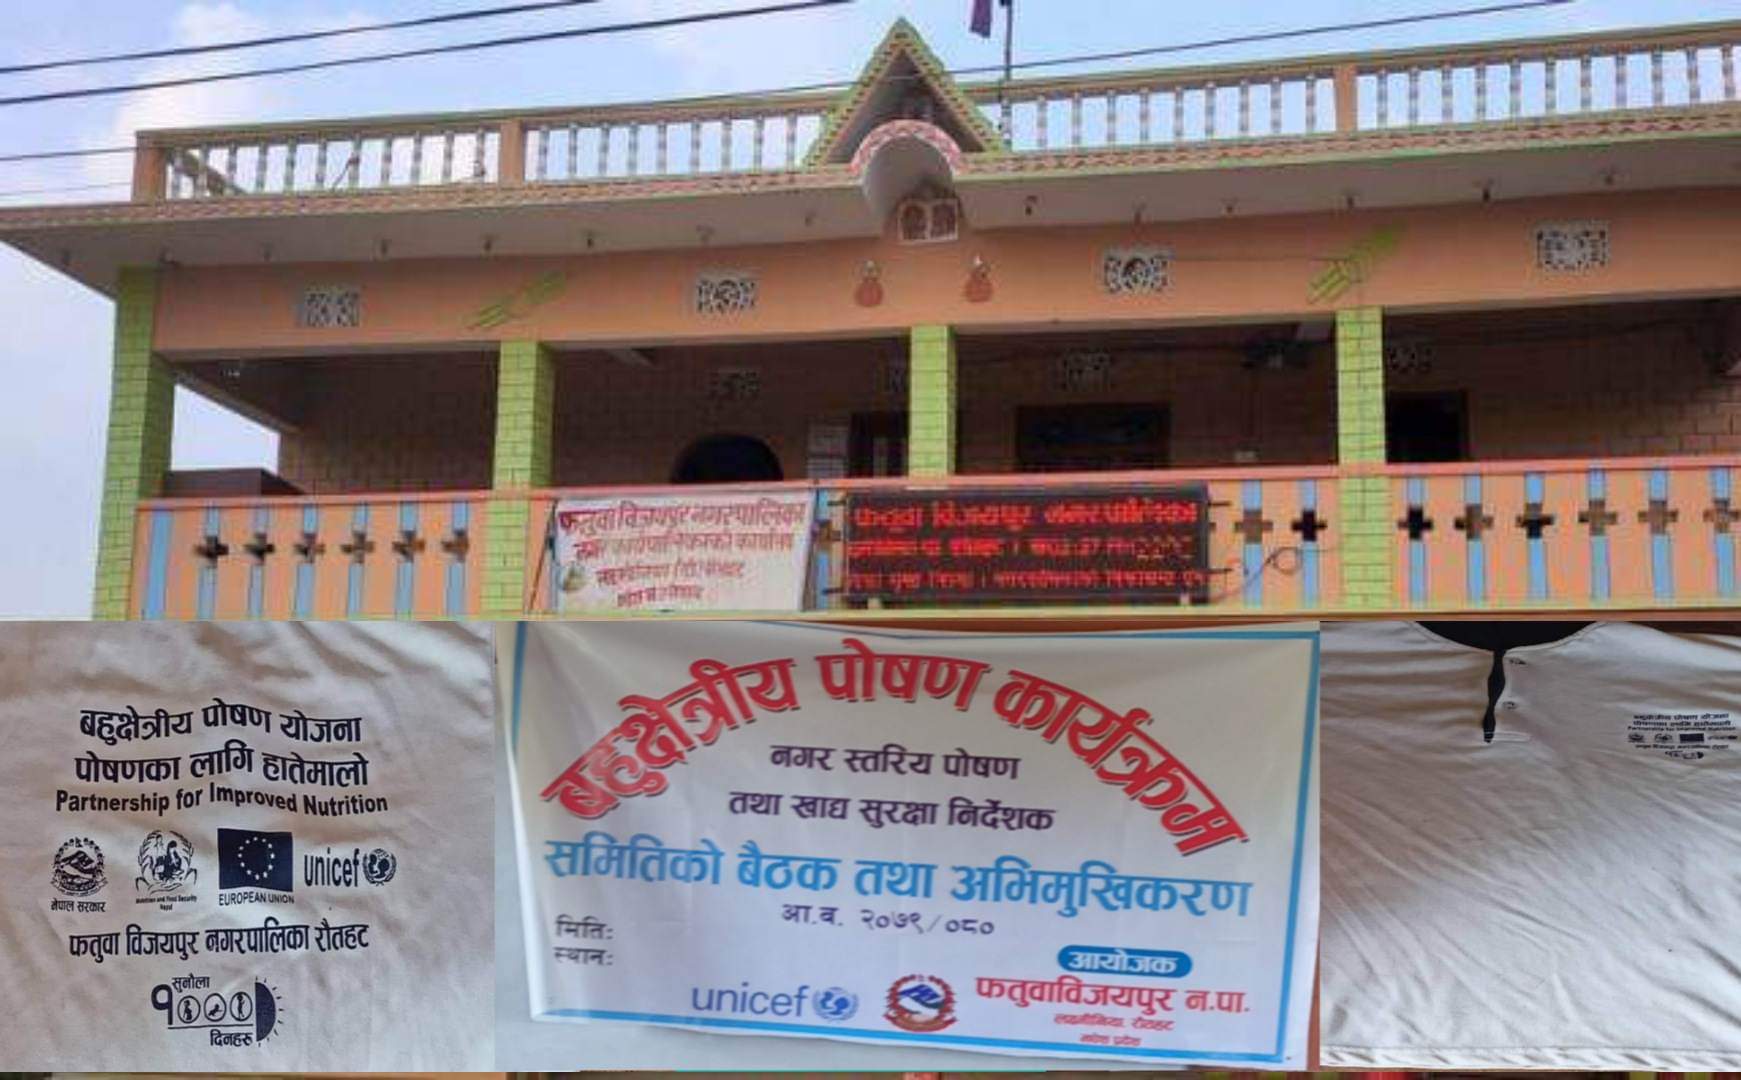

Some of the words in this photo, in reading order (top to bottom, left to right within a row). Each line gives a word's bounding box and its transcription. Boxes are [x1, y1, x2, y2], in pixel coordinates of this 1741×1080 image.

[80, 705, 194, 746] बहुक्षेत्रीय
[202, 698, 272, 733] पोषण
[280, 710, 362, 742] योजना
[75, 751, 182, 783] पोषणका
[190, 739, 254, 777] लागि
[262, 752, 369, 787] हातेमालो
[540, 657, 800, 819] बहुक्षेत्रीय
[815, 638, 993, 711] पोषण
[993, 668, 1250, 857] कार्यक्रम
[769, 743, 836, 774] नगर
[844, 746, 931, 777] स्तरिय
[942, 748, 1021, 780] पोषण
[55, 789, 170, 816] Partnership
[177, 788, 203, 810] for
[210, 783, 298, 813] Improved
[304, 795, 389, 817] Nutrition
[729, 789, 781, 817] तथा
[791, 791, 850, 825] खाद्य
[858, 797, 937, 831] सुरक्षा
[947, 794, 1055, 833] निर्देशक
[303, 847, 361, 888] unicef
[544, 831, 722, 885] समितिको
[738, 840, 840, 892] बैठक
[854, 859, 936, 900] तथा
[953, 855, 1252, 918] अभिमुखिकरण
[51, 898, 75, 913] नेपाल
[77, 901, 107, 913] सरकार
[219, 893, 266, 906] EUROPEAN
[268, 893, 295, 905] UNION
[69, 931, 121, 964] फतुवा
[126, 924, 200, 960] विजयपुर
[205, 916, 310, 956] नगरपालिका
[315, 917, 370, 952] रौतहट
[1068, 950, 1178, 975] आयोजक
[172, 973, 210, 993] सुनौला
[691, 982, 810, 1018] unicef
[1185, 990, 1250, 1013] न.पा.
